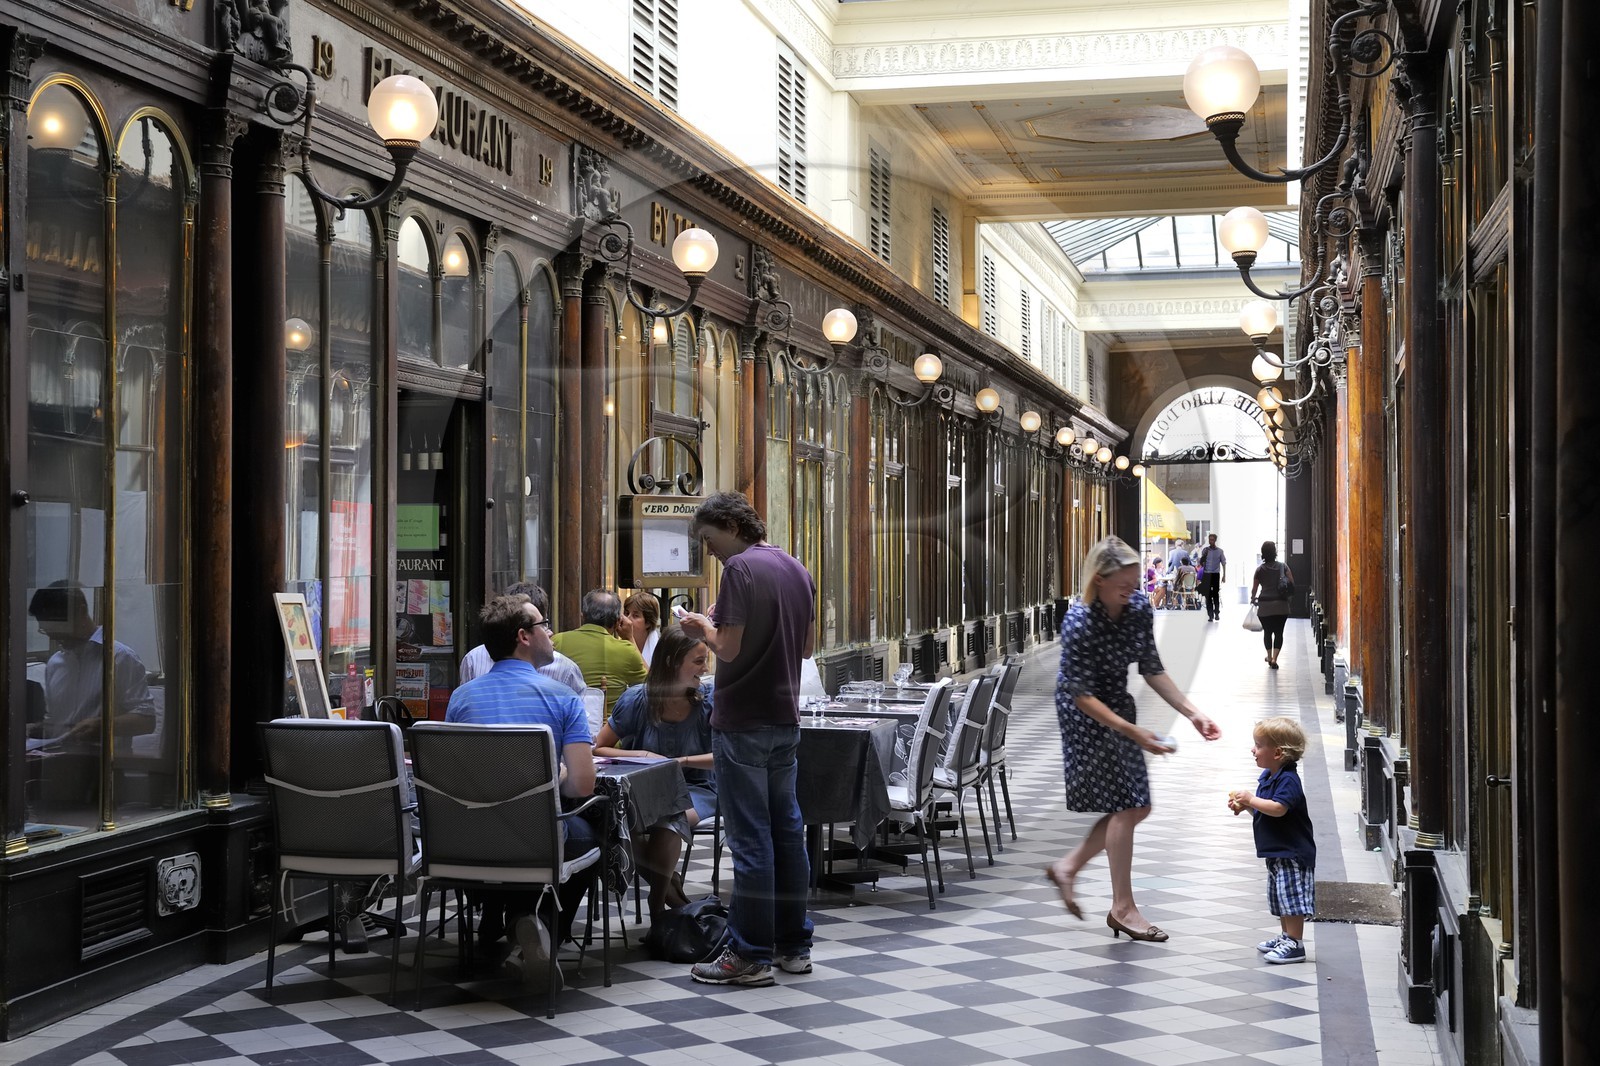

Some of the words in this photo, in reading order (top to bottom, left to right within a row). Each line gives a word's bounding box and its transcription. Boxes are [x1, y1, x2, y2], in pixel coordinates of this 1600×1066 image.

[311, 35, 335, 80] 19
[363, 47, 519, 176] RAURANT
[538, 153, 554, 188] 19
[651, 202, 670, 247] BY
[644, 505, 669, 513] VERO
